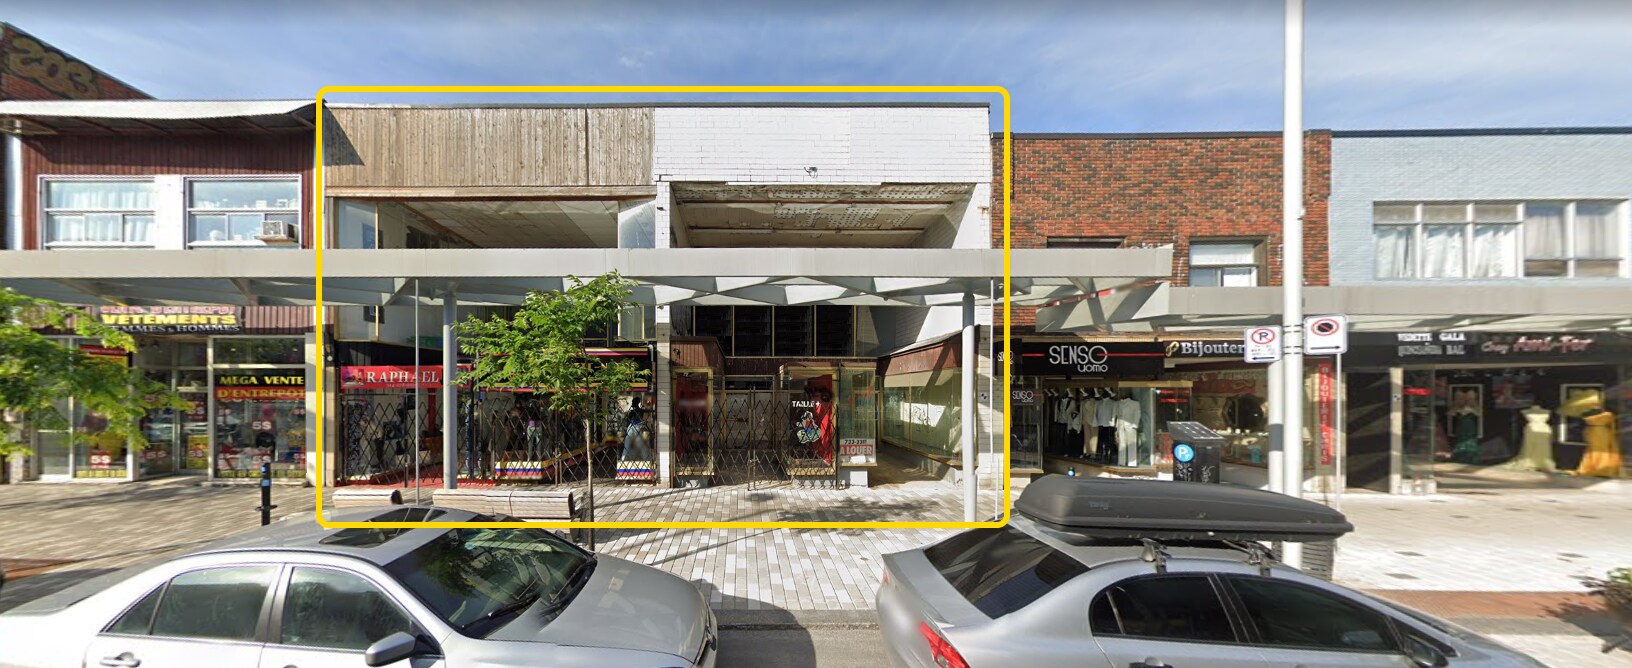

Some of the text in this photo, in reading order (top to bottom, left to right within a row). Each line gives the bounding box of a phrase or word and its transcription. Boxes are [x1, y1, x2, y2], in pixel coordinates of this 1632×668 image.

[101, 314, 236, 325] VETEMENTS
[175, 325, 240, 333] HOMMES
[1049, 345, 1108, 365] SENSO
[220, 376, 304, 385] MEGA VENTE
[846, 445, 873, 455] LOUER
